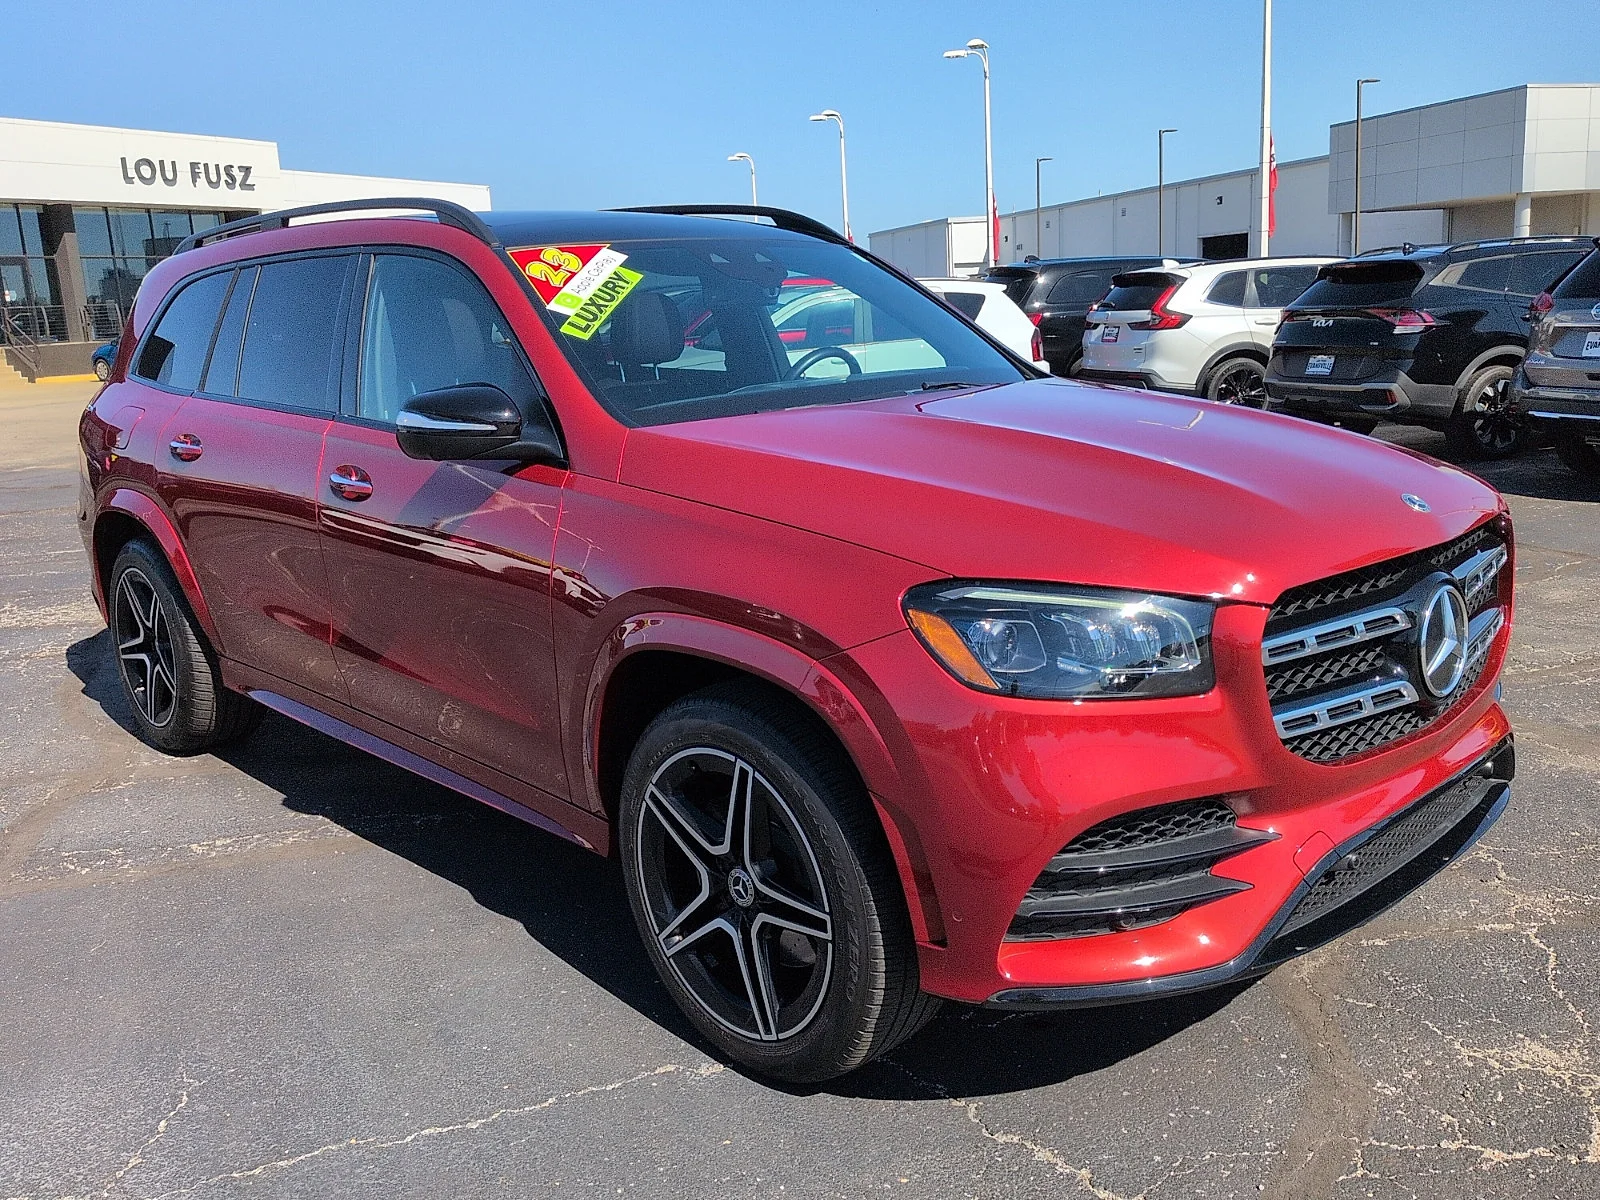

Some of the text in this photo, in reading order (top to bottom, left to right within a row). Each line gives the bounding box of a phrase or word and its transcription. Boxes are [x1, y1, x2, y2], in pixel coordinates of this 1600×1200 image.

[120, 157, 256, 191] LOU FUSZ
[527, 248, 582, 287] 23
[567, 271, 633, 333] LUXURY
